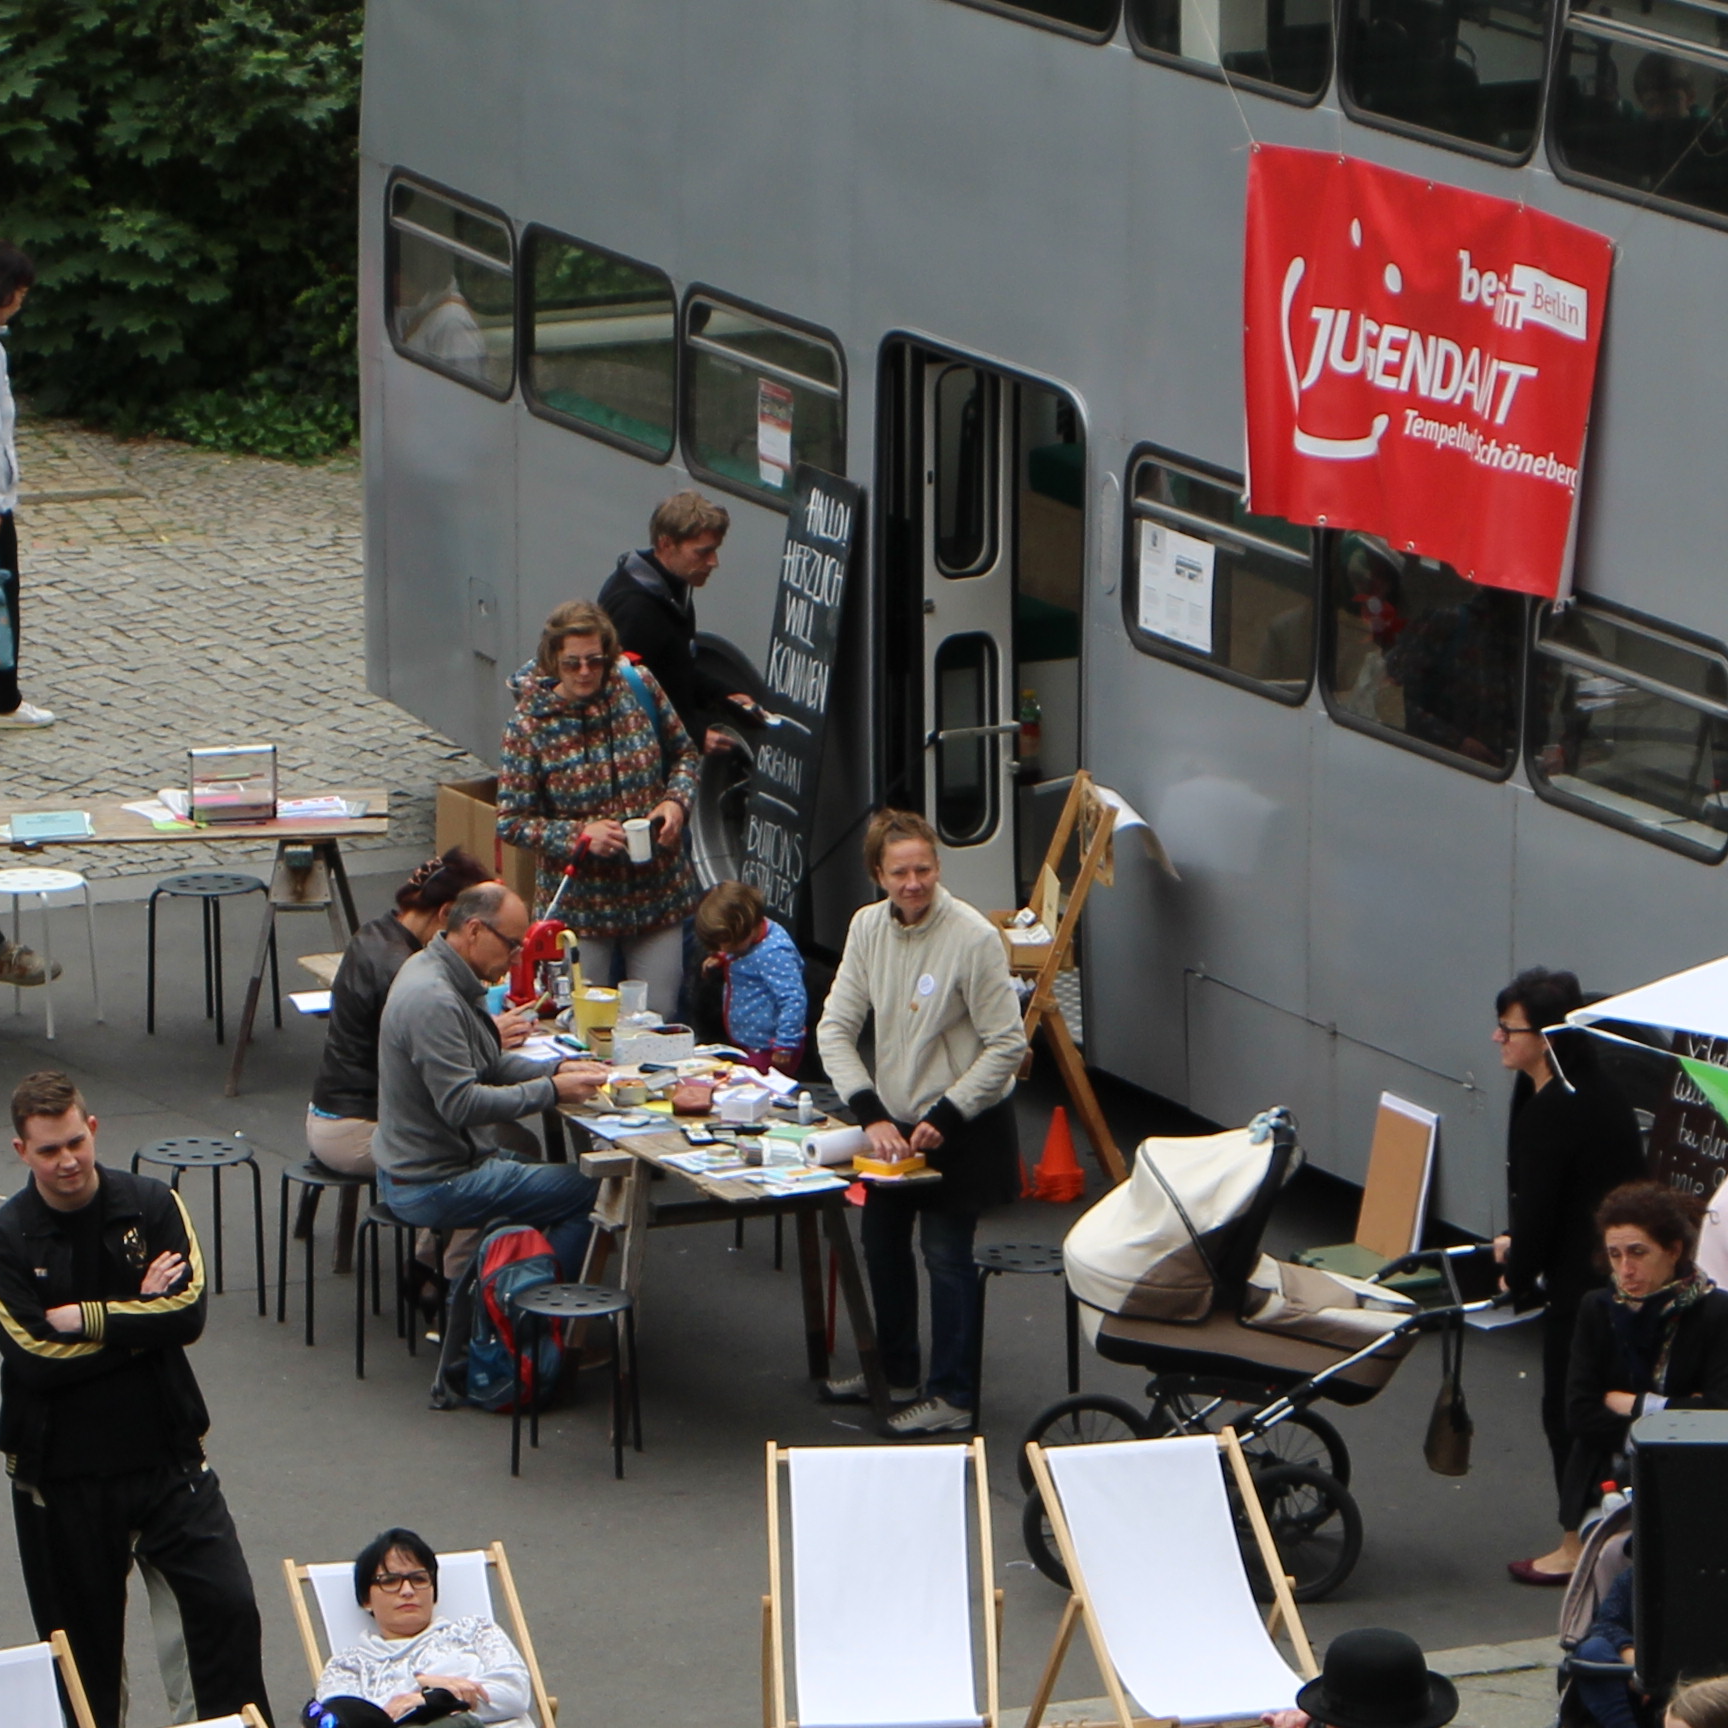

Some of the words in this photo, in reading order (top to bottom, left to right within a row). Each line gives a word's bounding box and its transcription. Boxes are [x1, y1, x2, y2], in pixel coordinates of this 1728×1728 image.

[1531, 281, 1581, 327] Berlin
[782, 538, 846, 609] HERZLICH
[783, 590, 816, 650] WILL
[768, 636, 831, 714] KOMMEN
